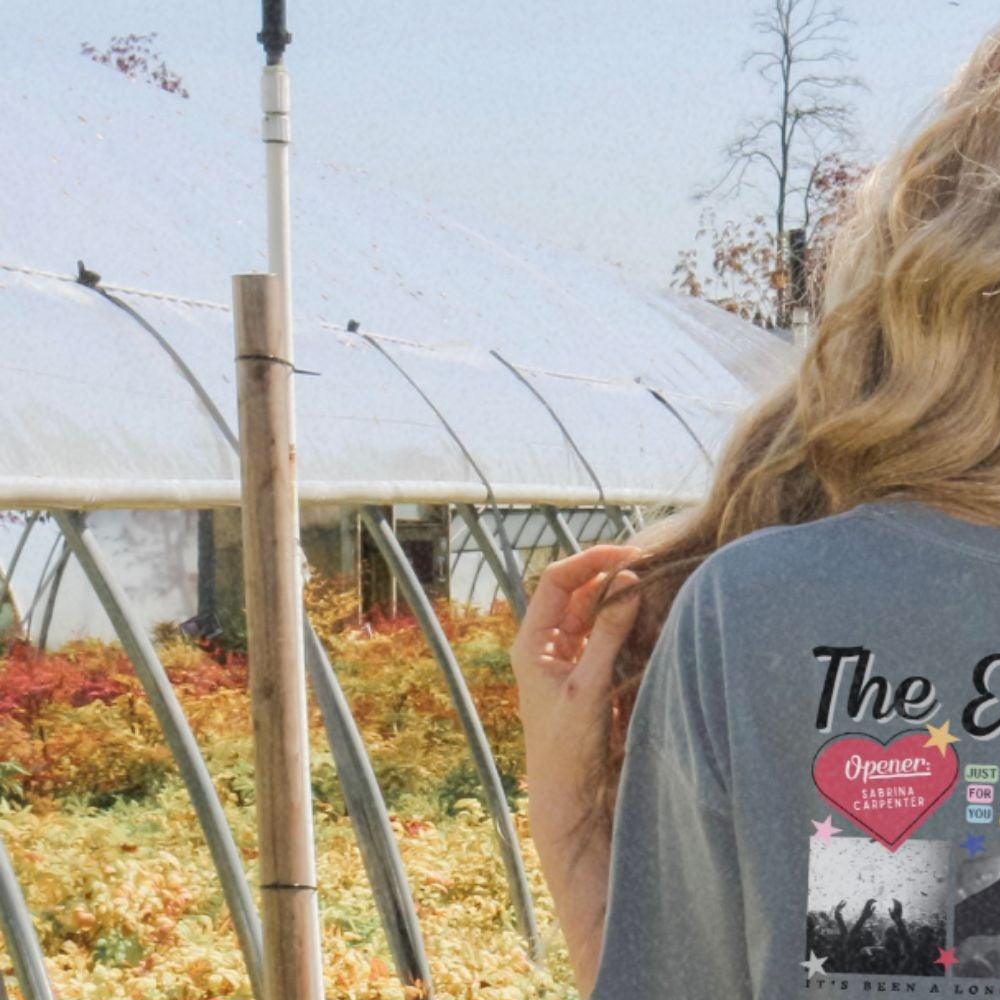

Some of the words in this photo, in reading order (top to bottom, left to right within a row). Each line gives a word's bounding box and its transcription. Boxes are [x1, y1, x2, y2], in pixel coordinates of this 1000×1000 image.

[812, 645, 941, 733] The
[966, 767, 996, 779] JUST
[861, 786, 915, 799] SABRINA
[968, 787, 992, 799] FOR
[853, 796, 925, 811] CARPENTER
[967, 808, 992, 819] YOU
[805, 979, 849, 990] IT'S
[863, 981, 917, 993] BEEN
[928, 983, 941, 994] A
